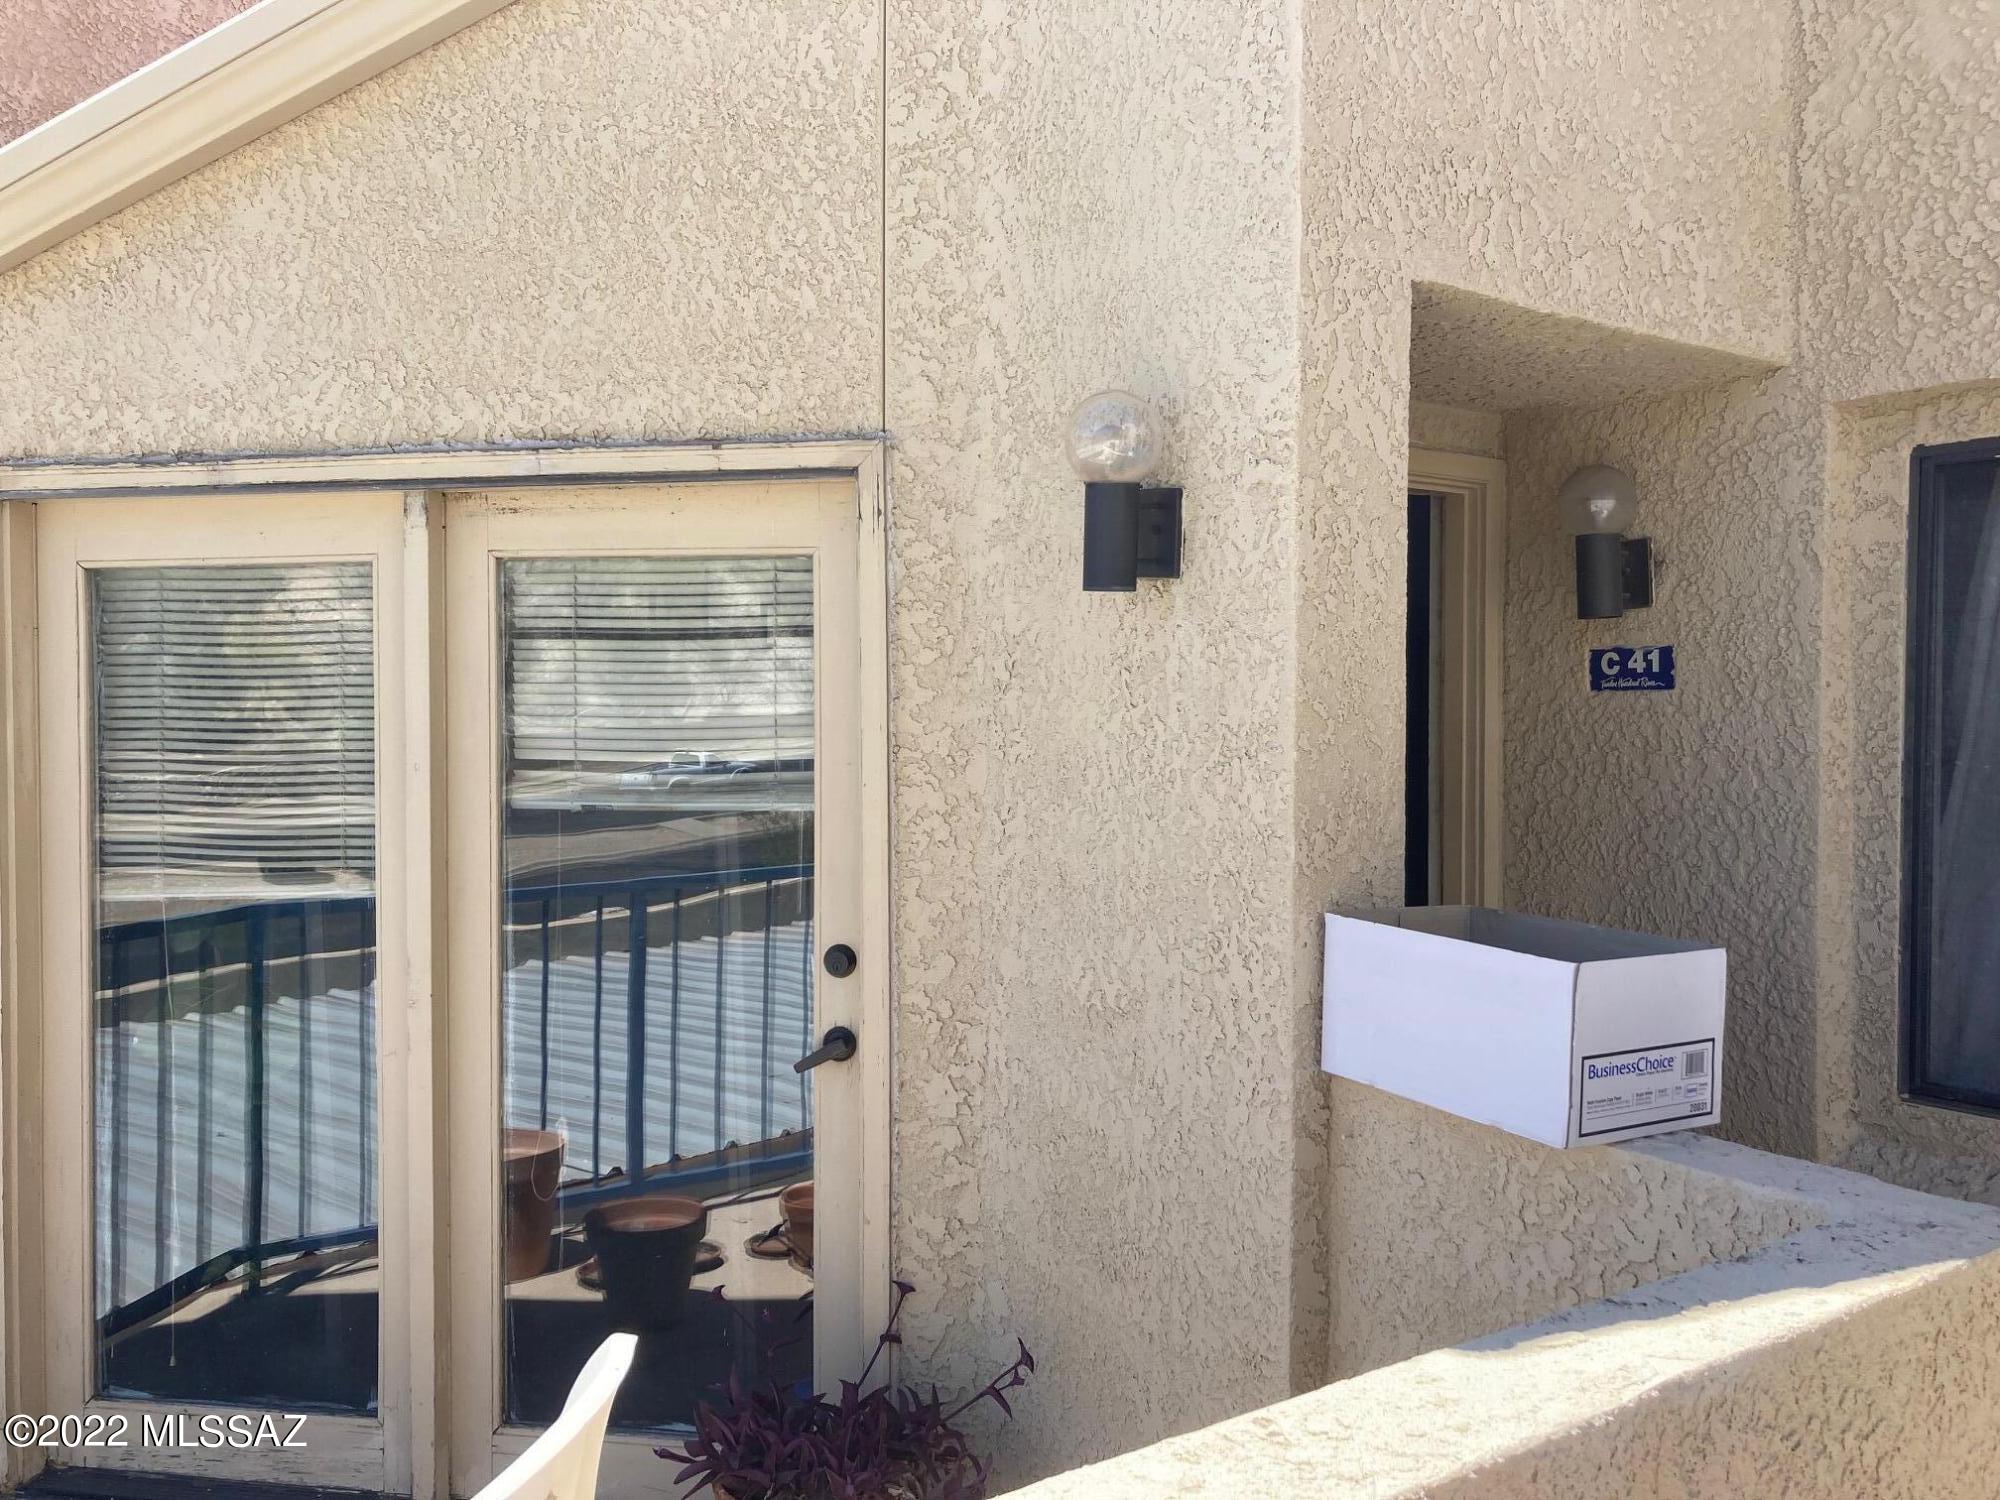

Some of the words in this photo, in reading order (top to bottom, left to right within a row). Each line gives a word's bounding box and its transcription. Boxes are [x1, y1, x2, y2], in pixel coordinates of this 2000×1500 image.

[1600, 651, 1621, 675] C
[1627, 648, 1660, 673] 41
[1588, 1054, 1675, 1080] BusinessChoice
